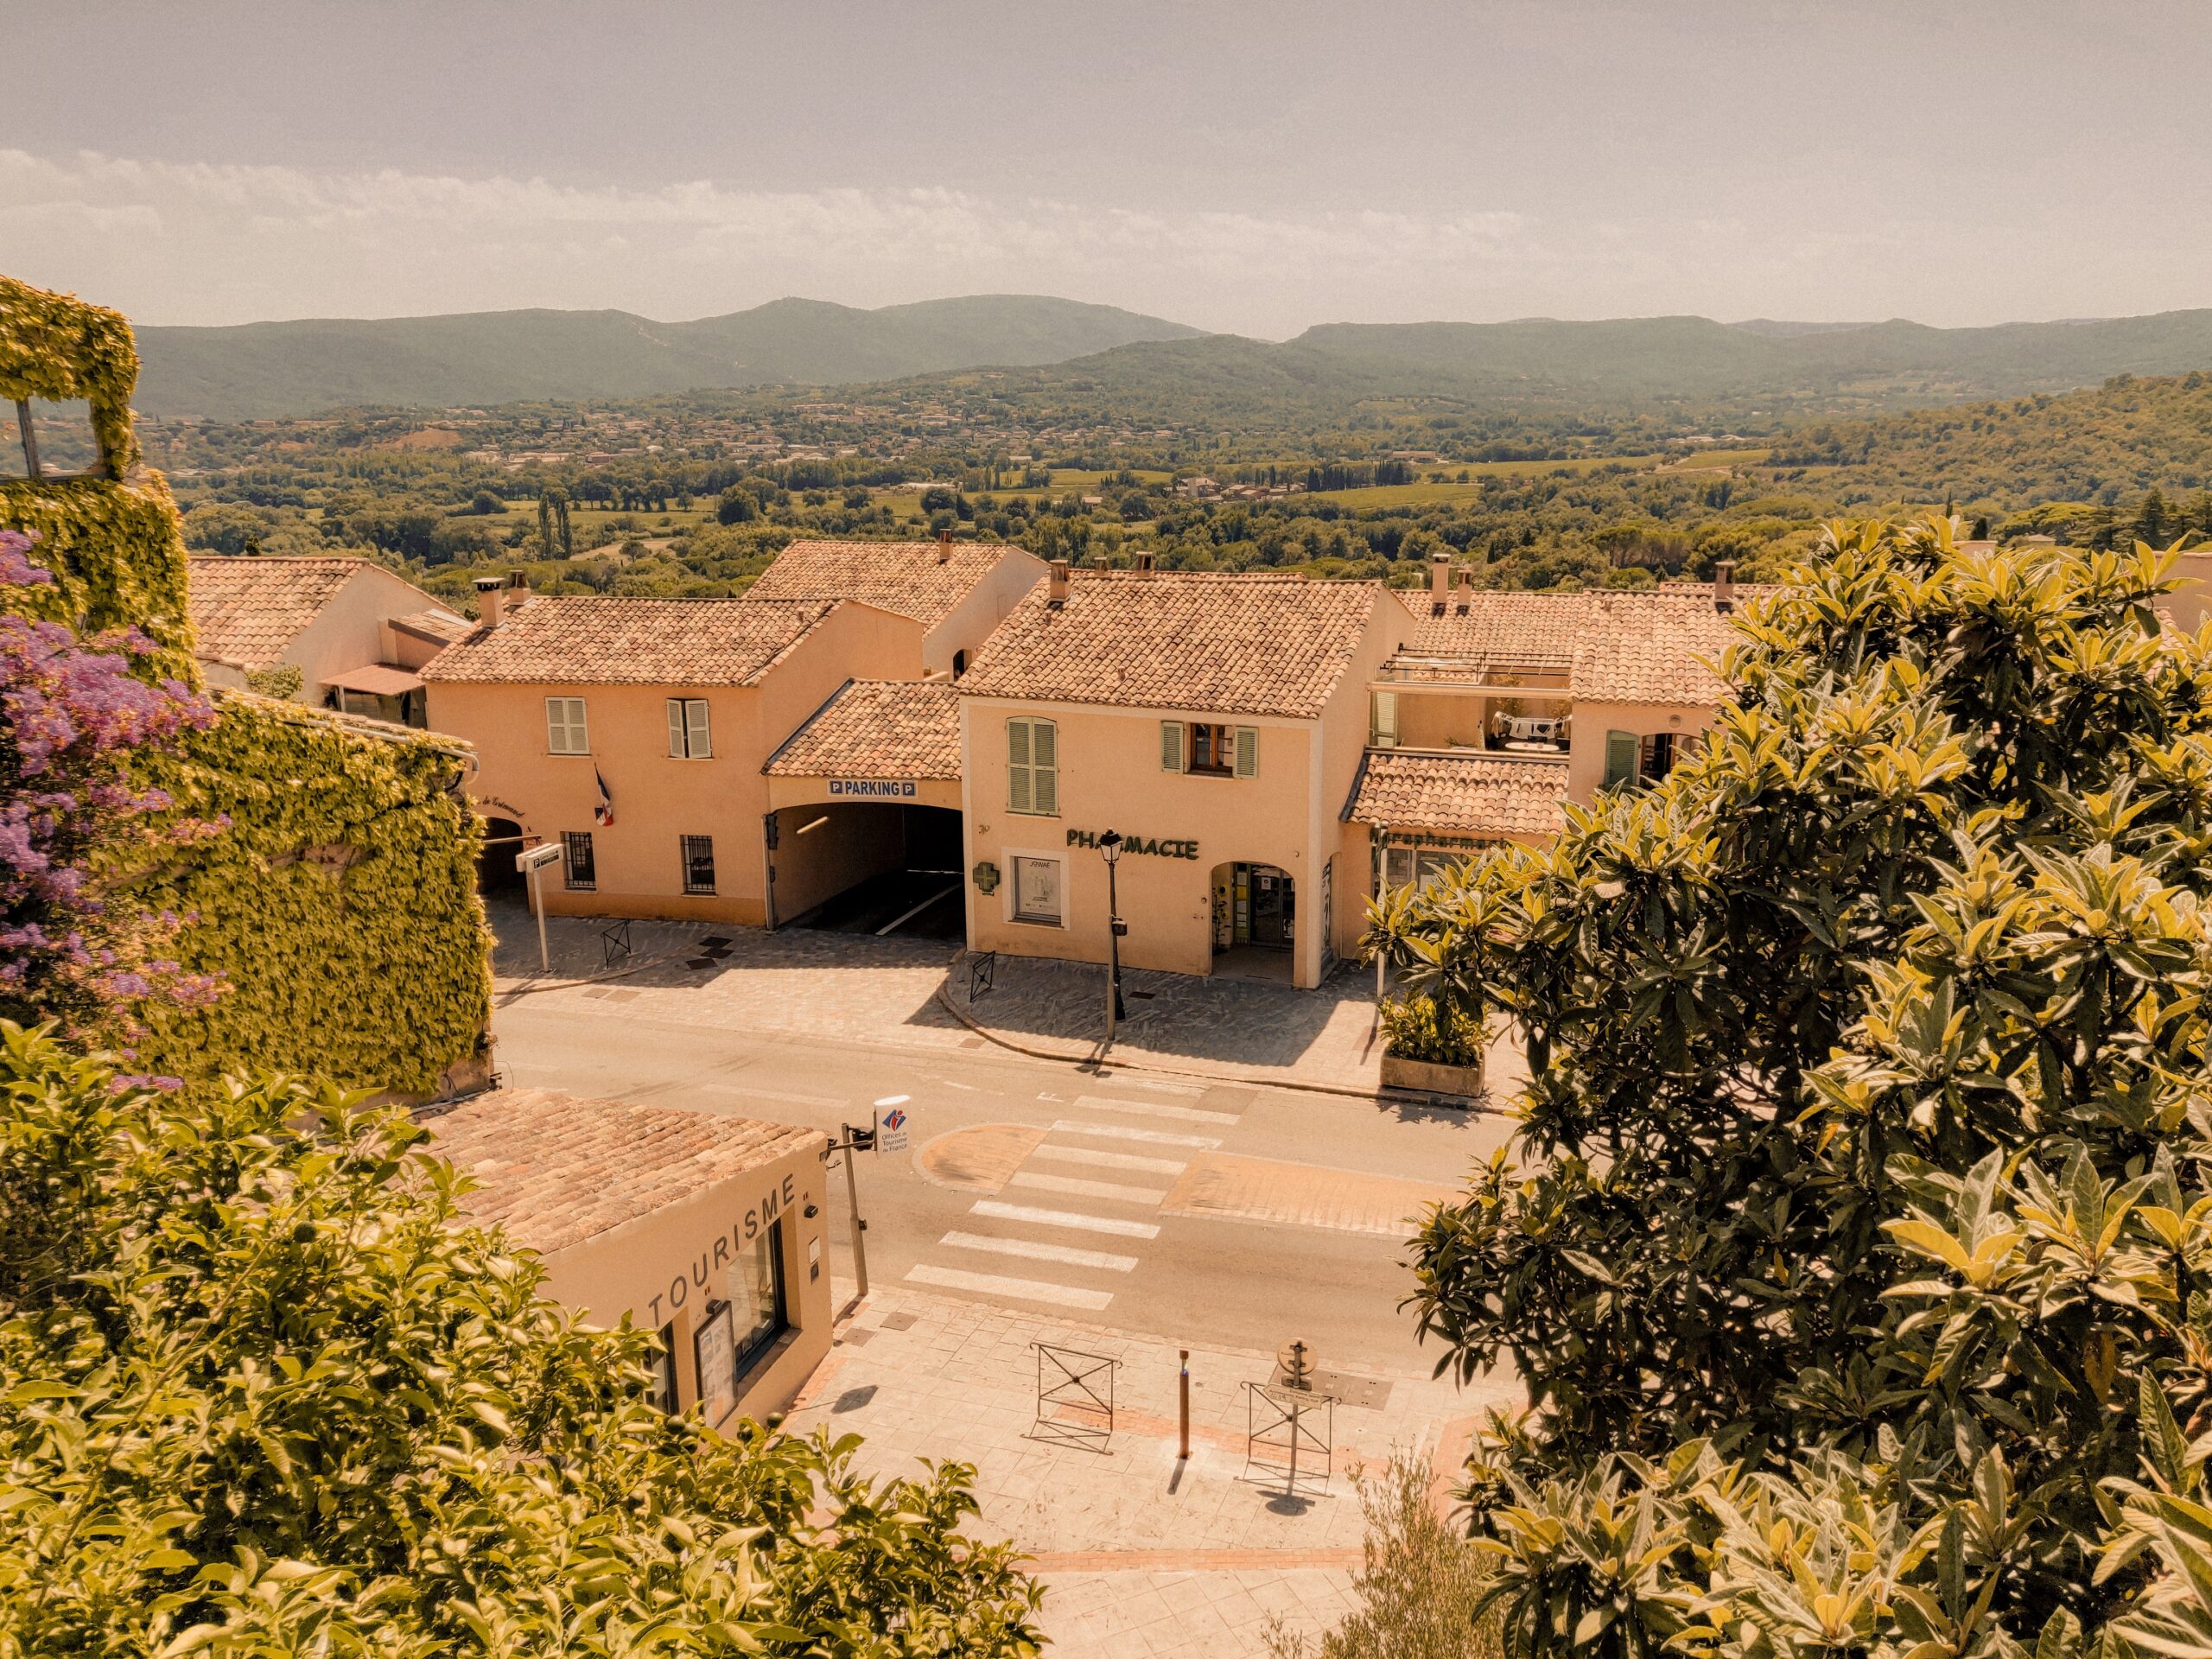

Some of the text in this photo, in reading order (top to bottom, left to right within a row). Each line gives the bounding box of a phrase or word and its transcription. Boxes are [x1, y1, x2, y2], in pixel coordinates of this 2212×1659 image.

[845, 781, 899, 795] PARKING
[1067, 829, 1199, 860] PHMACIE
[883, 1137, 907, 1147] Tourisme
[649, 1173, 795, 1327] TOURISME
